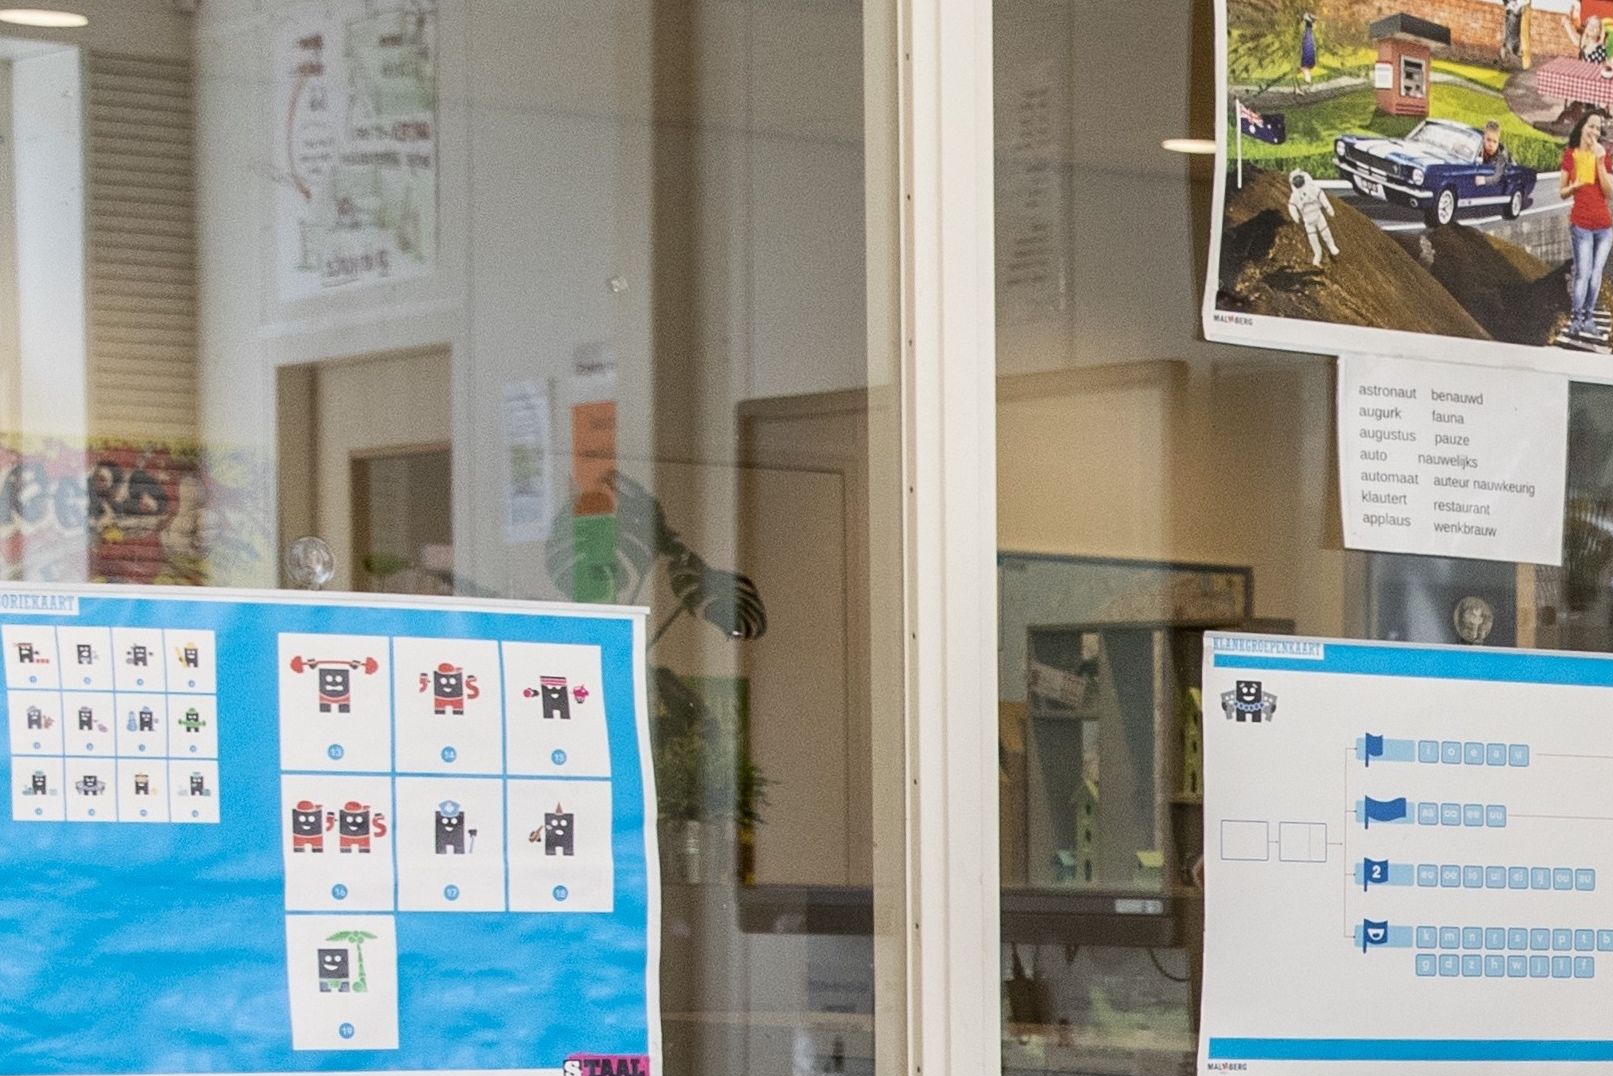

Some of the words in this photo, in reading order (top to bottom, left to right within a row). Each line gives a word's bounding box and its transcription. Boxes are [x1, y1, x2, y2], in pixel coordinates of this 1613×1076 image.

[1358, 384, 1417, 400] astronaut
[1431, 389, 1484, 405] benauwd
[1359, 406, 1402, 420] augurk
[1432, 410, 1465, 424] fauna
[1359, 427, 1417, 442] augustus
[1434, 433, 1471, 447] pauze
[1360, 448, 1388, 461] auto
[1418, 453, 1479, 470] nauwelijks
[1360, 470, 1419, 485] automaat
[1433, 475, 1470, 489] auteur
[1473, 480, 1536, 497] nauwkeurig
[1361, 490, 1408, 505] klautert
[1433, 500, 1491, 516] restaurant
[1362, 512, 1412, 527] applaus
[1433, 521, 1497, 537] wenkbrauw
[0, 594, 75, 611] ORIEKAART
